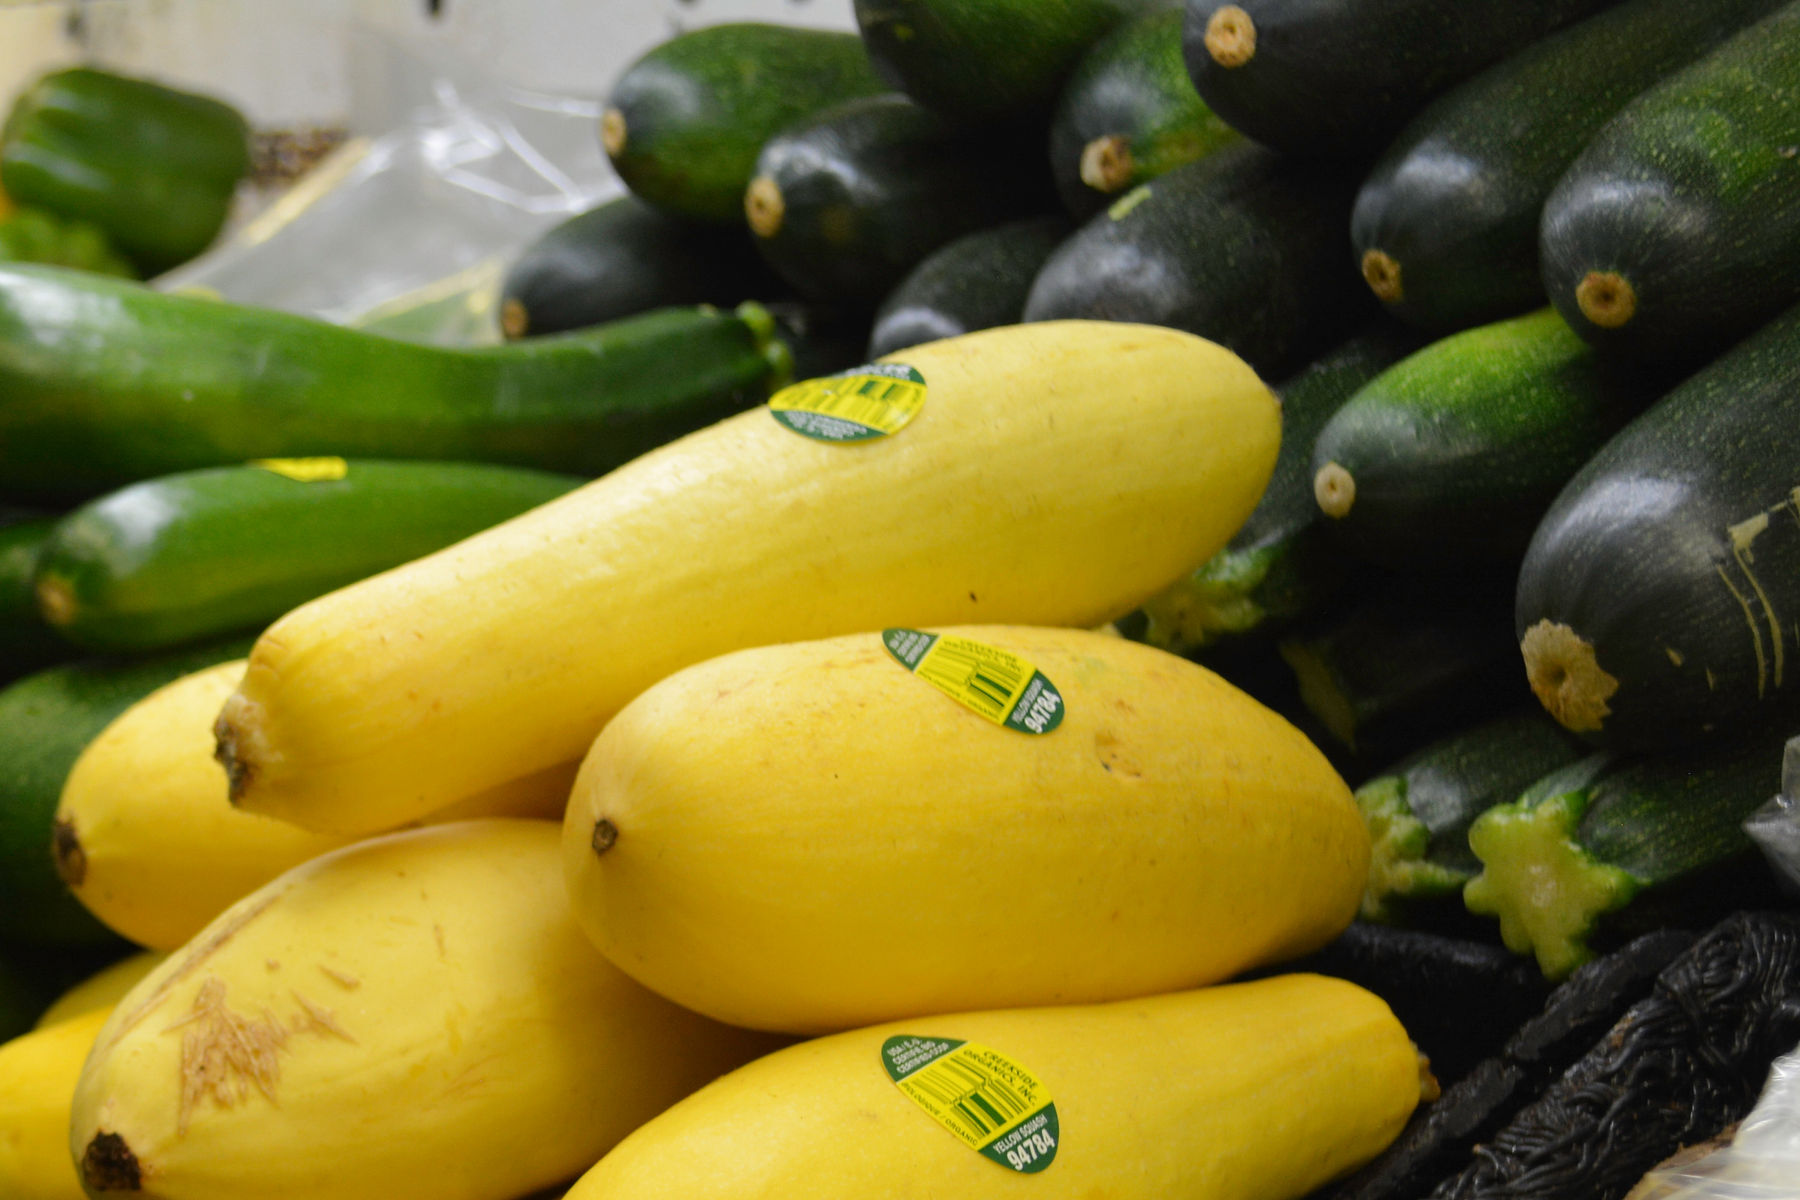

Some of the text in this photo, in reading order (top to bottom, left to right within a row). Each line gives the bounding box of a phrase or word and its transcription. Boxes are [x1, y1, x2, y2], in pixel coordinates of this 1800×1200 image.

[1024, 689, 1061, 734] 94784
[984, 1051, 1038, 1089] CREEKSIDE
[1017, 1085, 1038, 1106] INC.
[945, 1118, 978, 1146] ORGANIC
[993, 1113, 1048, 1154] YELLOW SQUASH
[1006, 1128, 1056, 1171] 94784
